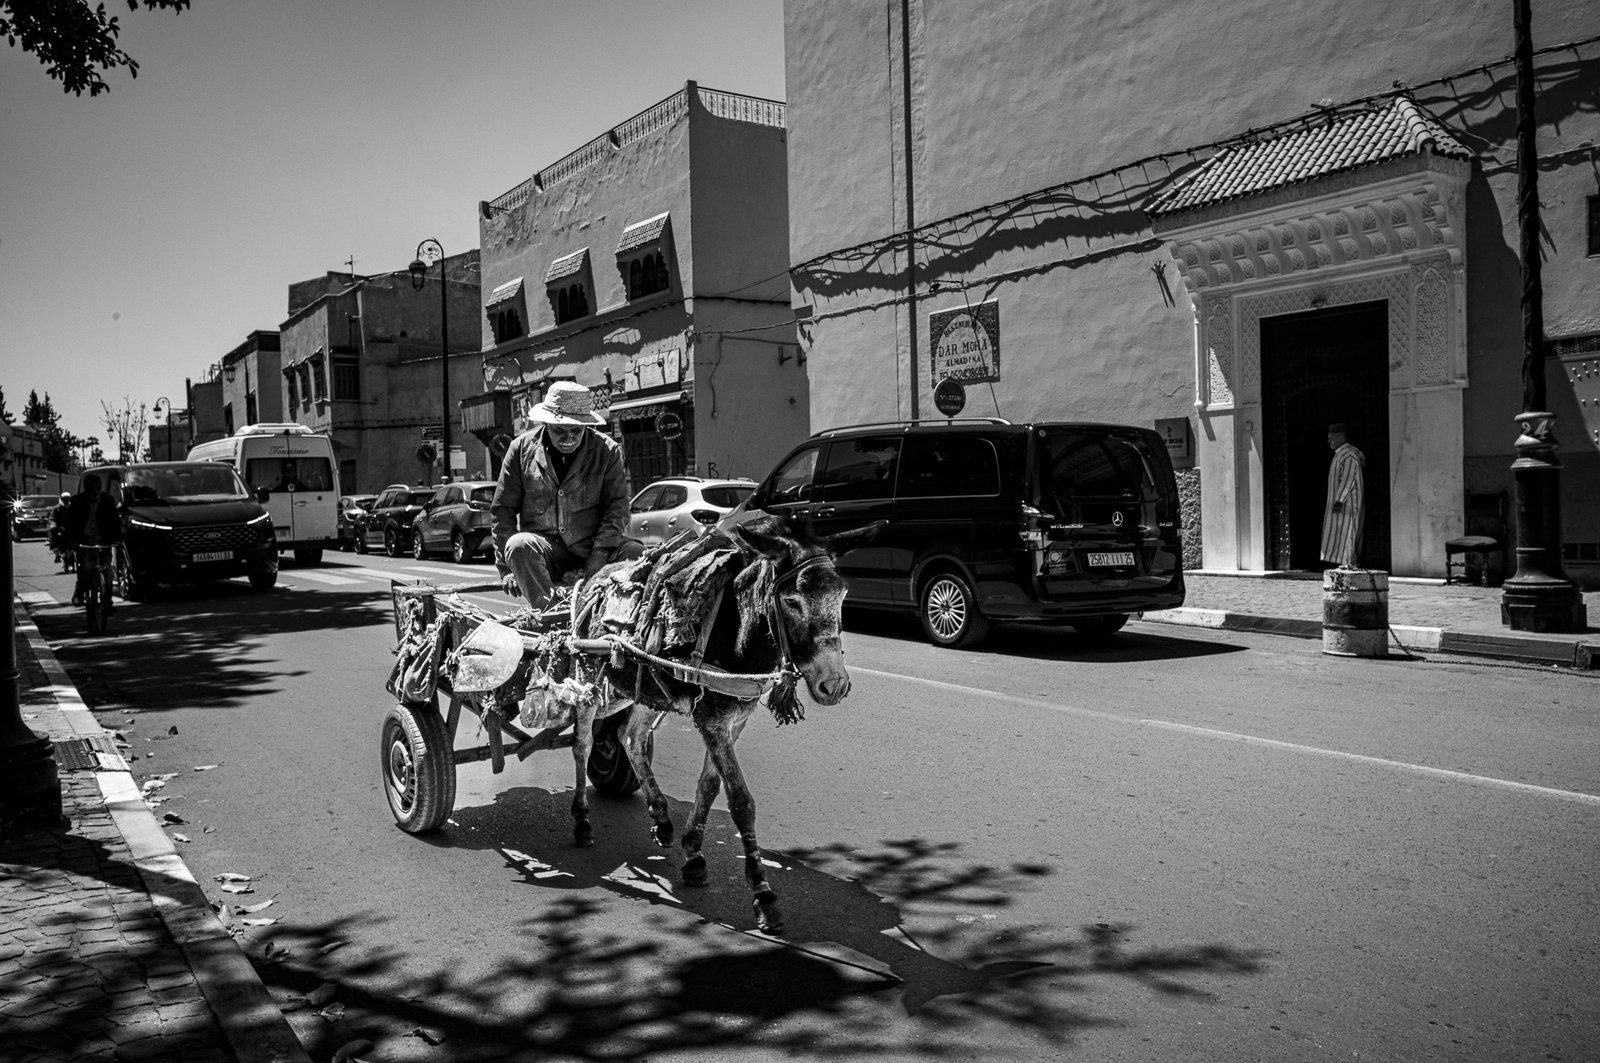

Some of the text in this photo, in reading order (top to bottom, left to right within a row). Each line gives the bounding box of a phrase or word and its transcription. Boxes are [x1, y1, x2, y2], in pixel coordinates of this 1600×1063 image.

[938, 338, 988, 358] DAR MOHA
[946, 355, 981, 367] ALMADINA
[1089, 553, 1133, 565] 25812 25
